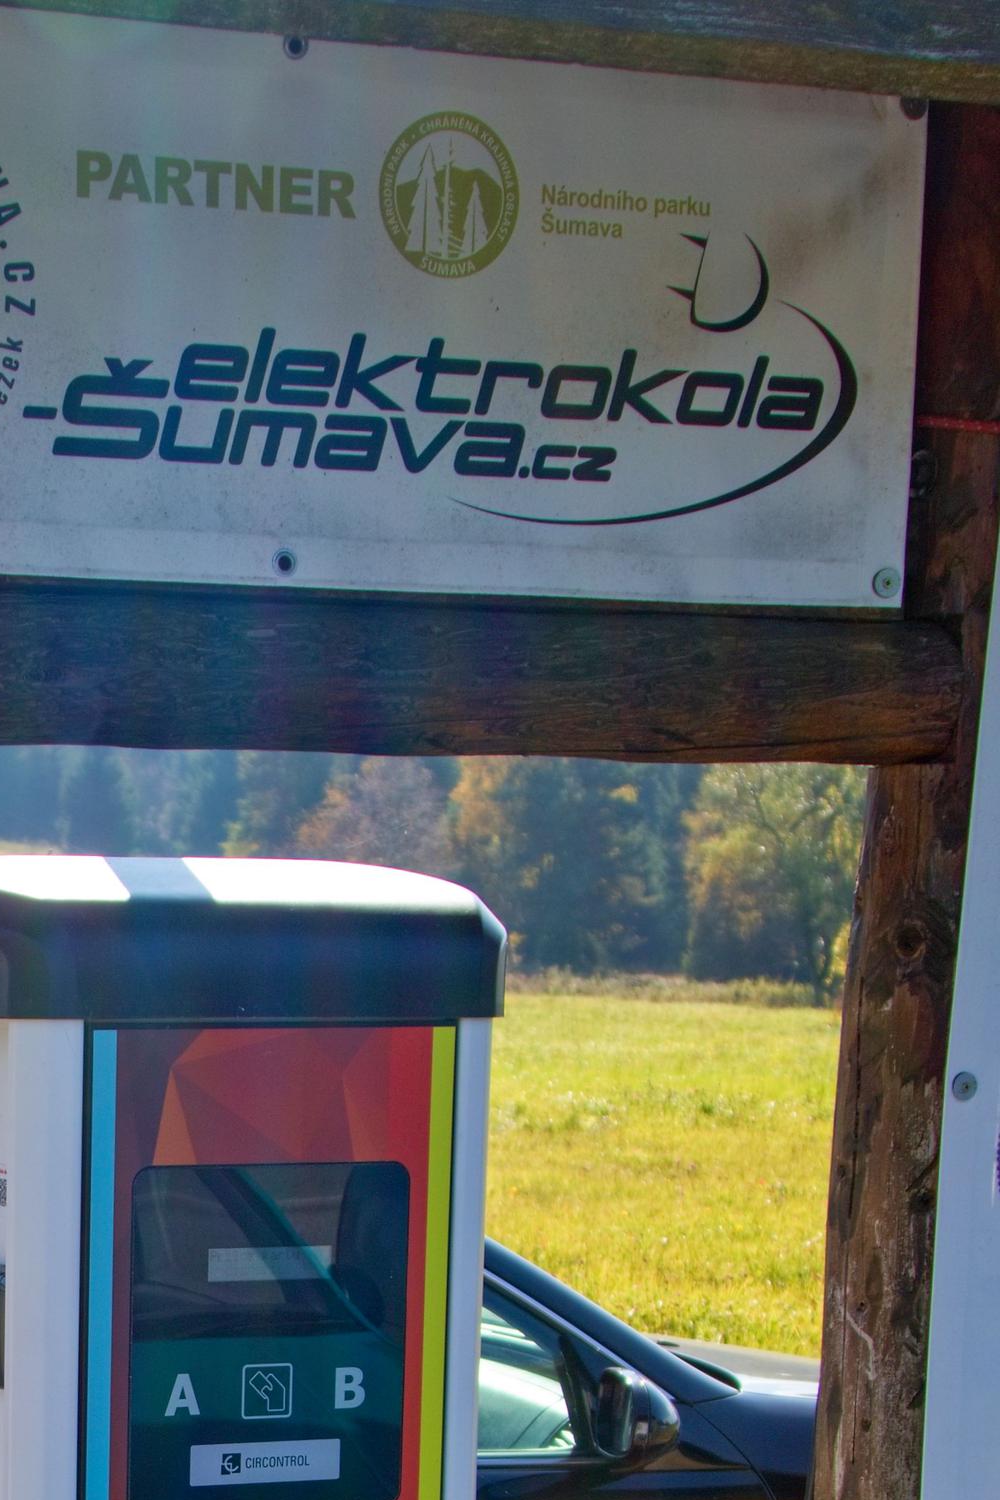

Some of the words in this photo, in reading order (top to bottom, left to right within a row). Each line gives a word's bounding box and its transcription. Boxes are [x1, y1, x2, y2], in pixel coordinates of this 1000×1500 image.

[76, 149, 356, 220] PARTNER
[540, 183, 648, 214] Národního
[654, 195, 713, 219] parku
[541, 207, 623, 239] Šumava
[420, 255, 477, 276] ŠUMAVA
[173, 326, 826, 433] elektrokola
[164, 1373, 201, 1417] A
[334, 1366, 366, 1410] B
[245, 1454, 311, 1470] CIRCONTROL
